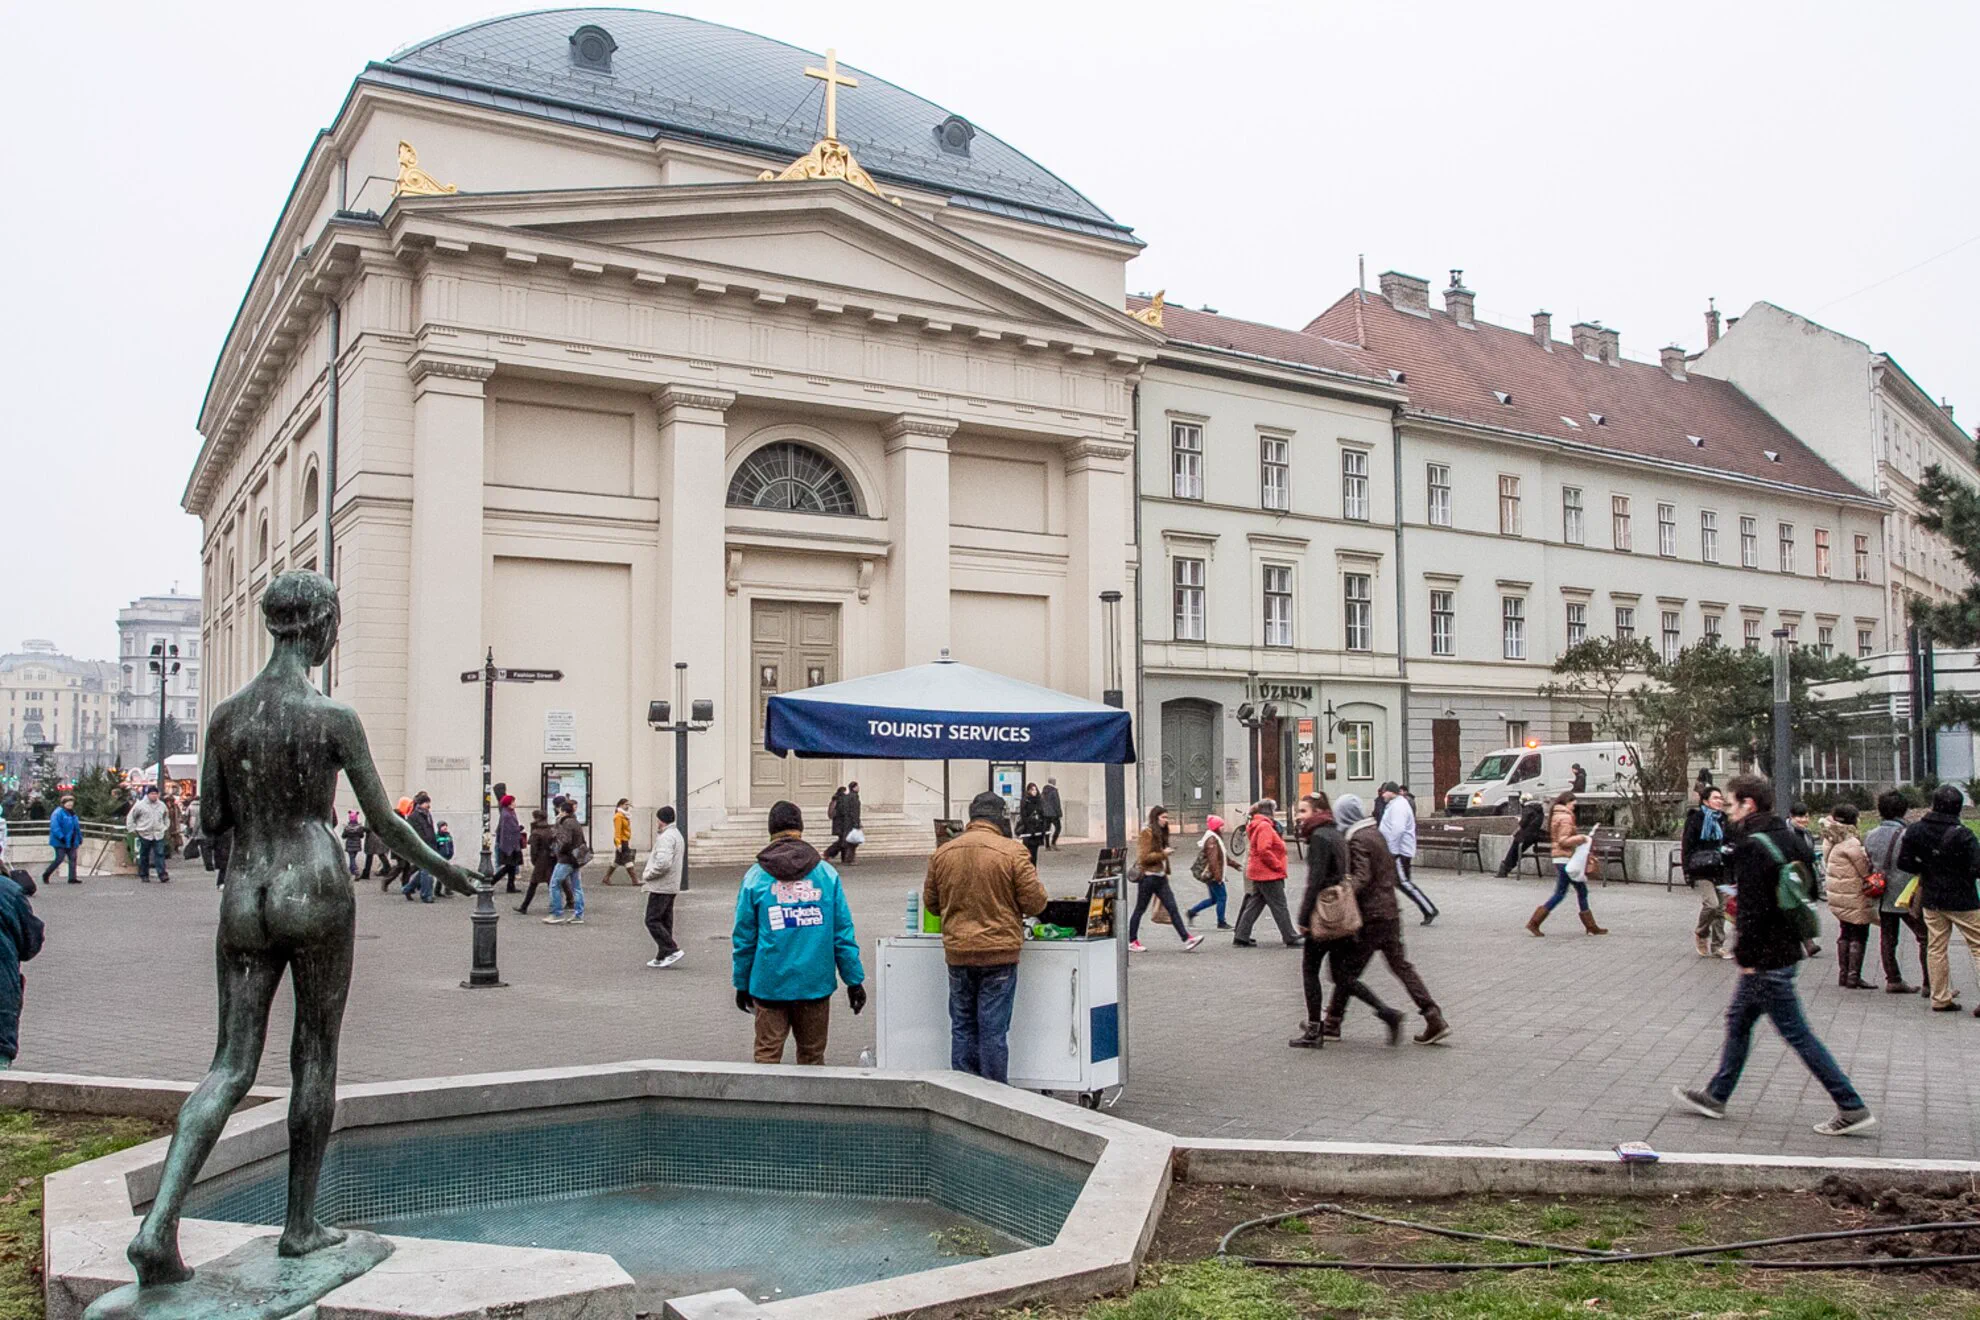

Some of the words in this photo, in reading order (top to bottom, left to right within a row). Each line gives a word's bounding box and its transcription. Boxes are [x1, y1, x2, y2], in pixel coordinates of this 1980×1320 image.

[513, 671, 535, 679] Fashion
[537, 672, 554, 680] Street
[868, 719, 944, 739] TOURIST
[948, 724, 1031, 743] SERVICES
[782, 907, 821, 919] Tickets
